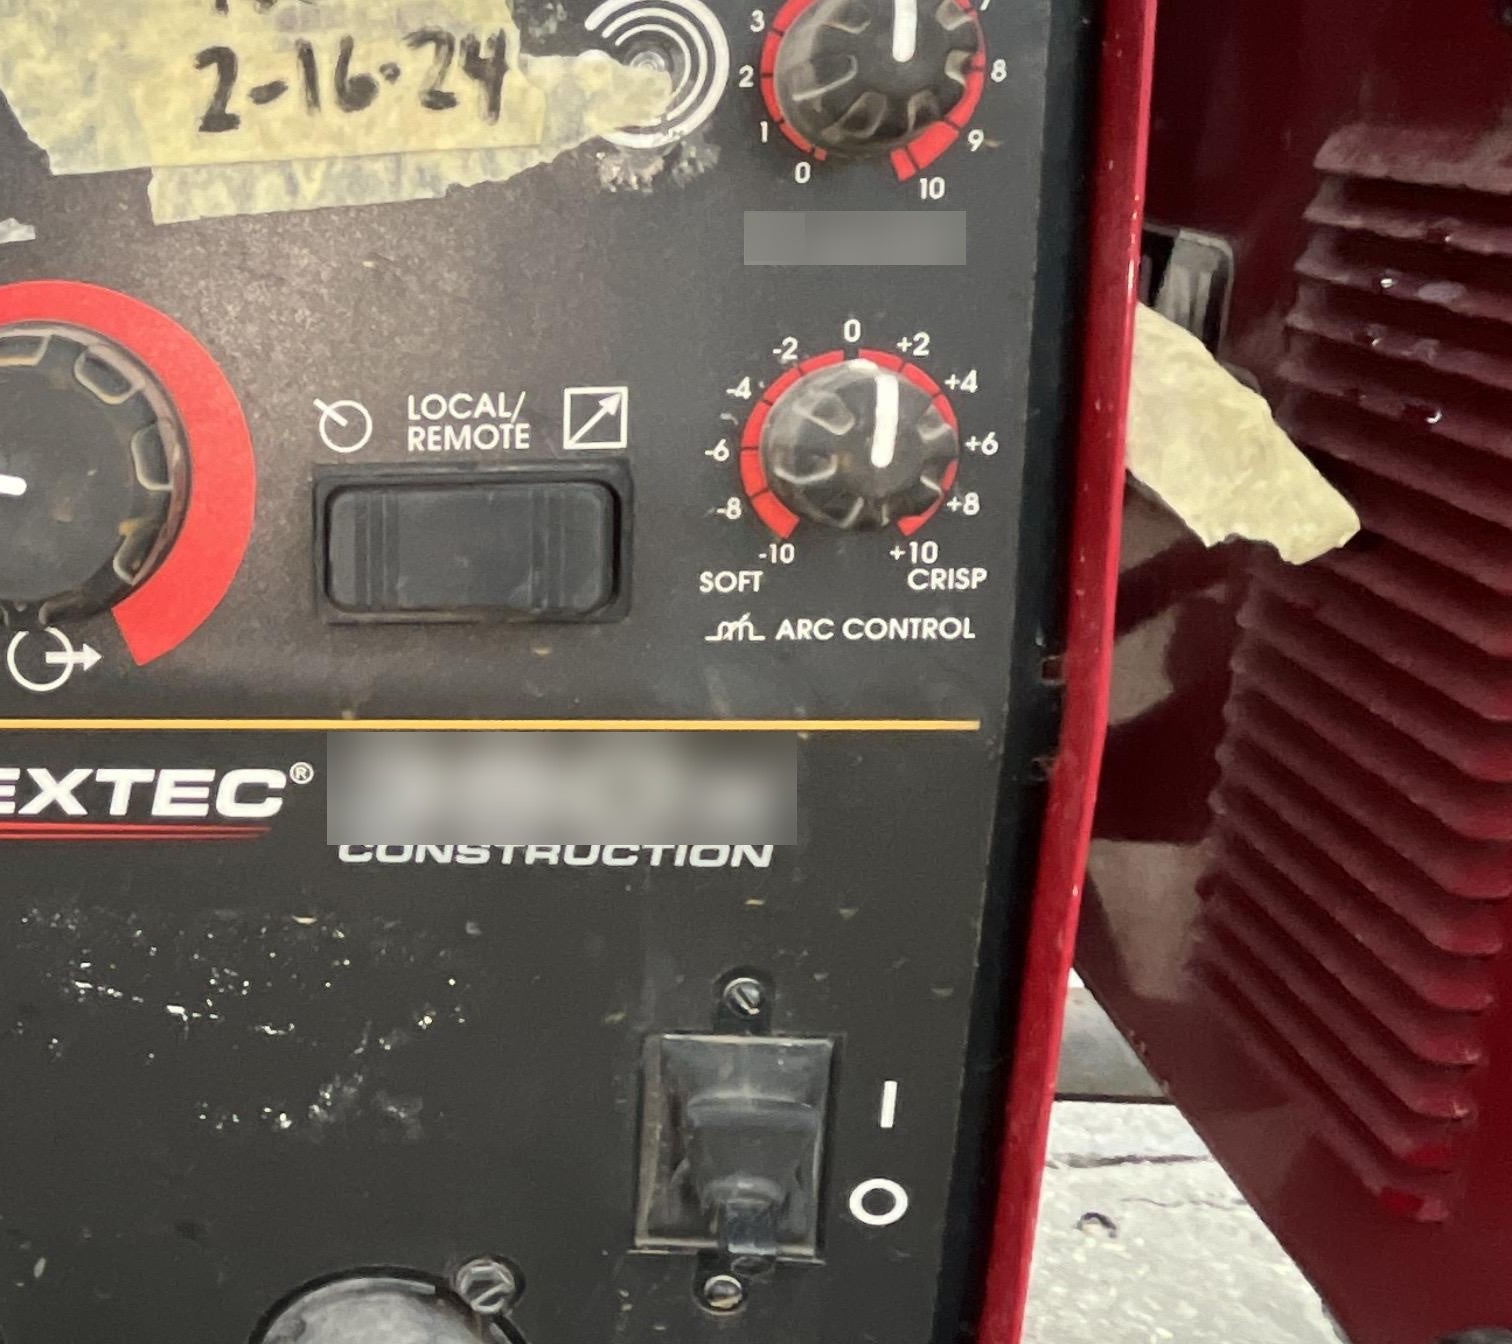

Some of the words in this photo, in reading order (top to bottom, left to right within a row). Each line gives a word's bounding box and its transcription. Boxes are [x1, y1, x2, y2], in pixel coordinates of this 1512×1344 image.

[750, 9, 765, 33] 3
[738, 64, 754, 88] 2
[990, 58, 1007, 83] 8
[759, 121, 769, 144] 1
[967, 129, 985, 152] 9
[794, 161, 811, 184] 0
[918, 176, 947, 201] 10
[843, 318, 861, 343] 0
[772, 336, 799, 364] -2
[896, 331, 931, 356] +2
[726, 376, 752, 400] -4
[944, 369, 979, 394] +4
[407, 390, 527, 423] LOCAL/
[407, 422, 531, 453] REMOTE
[965, 431, 999, 456] +6
[704, 438, 730, 462] -6
[716, 496, 742, 520] -8
[946, 492, 980, 516] +8
[758, 542, 796, 565] -10
[889, 540, 939, 564] +10
[699, 570, 764, 593] SOFT
[907, 567, 988, 591] CRISP
[775, 617, 835, 641] ARC
[842, 616, 976, 641] CONTROL
[338, 843, 775, 869] CONSTRUCTION
